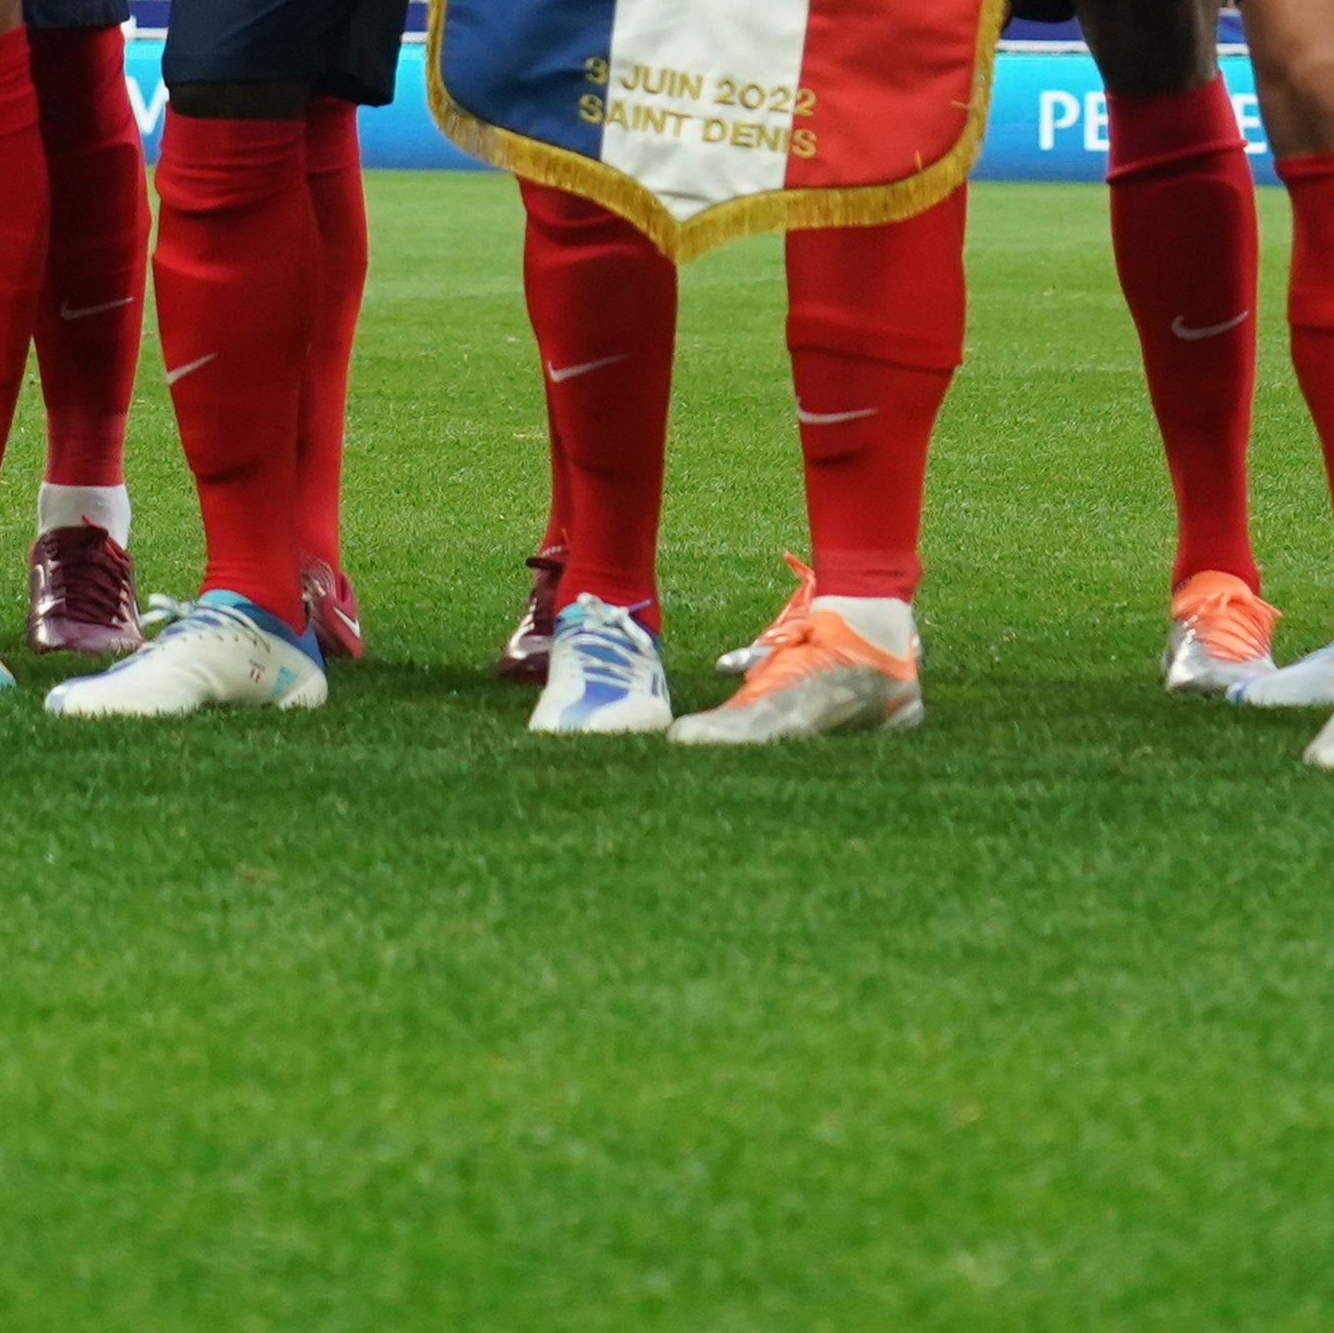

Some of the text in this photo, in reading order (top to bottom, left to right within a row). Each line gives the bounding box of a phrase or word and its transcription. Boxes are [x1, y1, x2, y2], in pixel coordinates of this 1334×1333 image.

[584, 56, 818, 118] 3 JUIN 2022
[578, 93, 818, 160] SAINT DENIS
